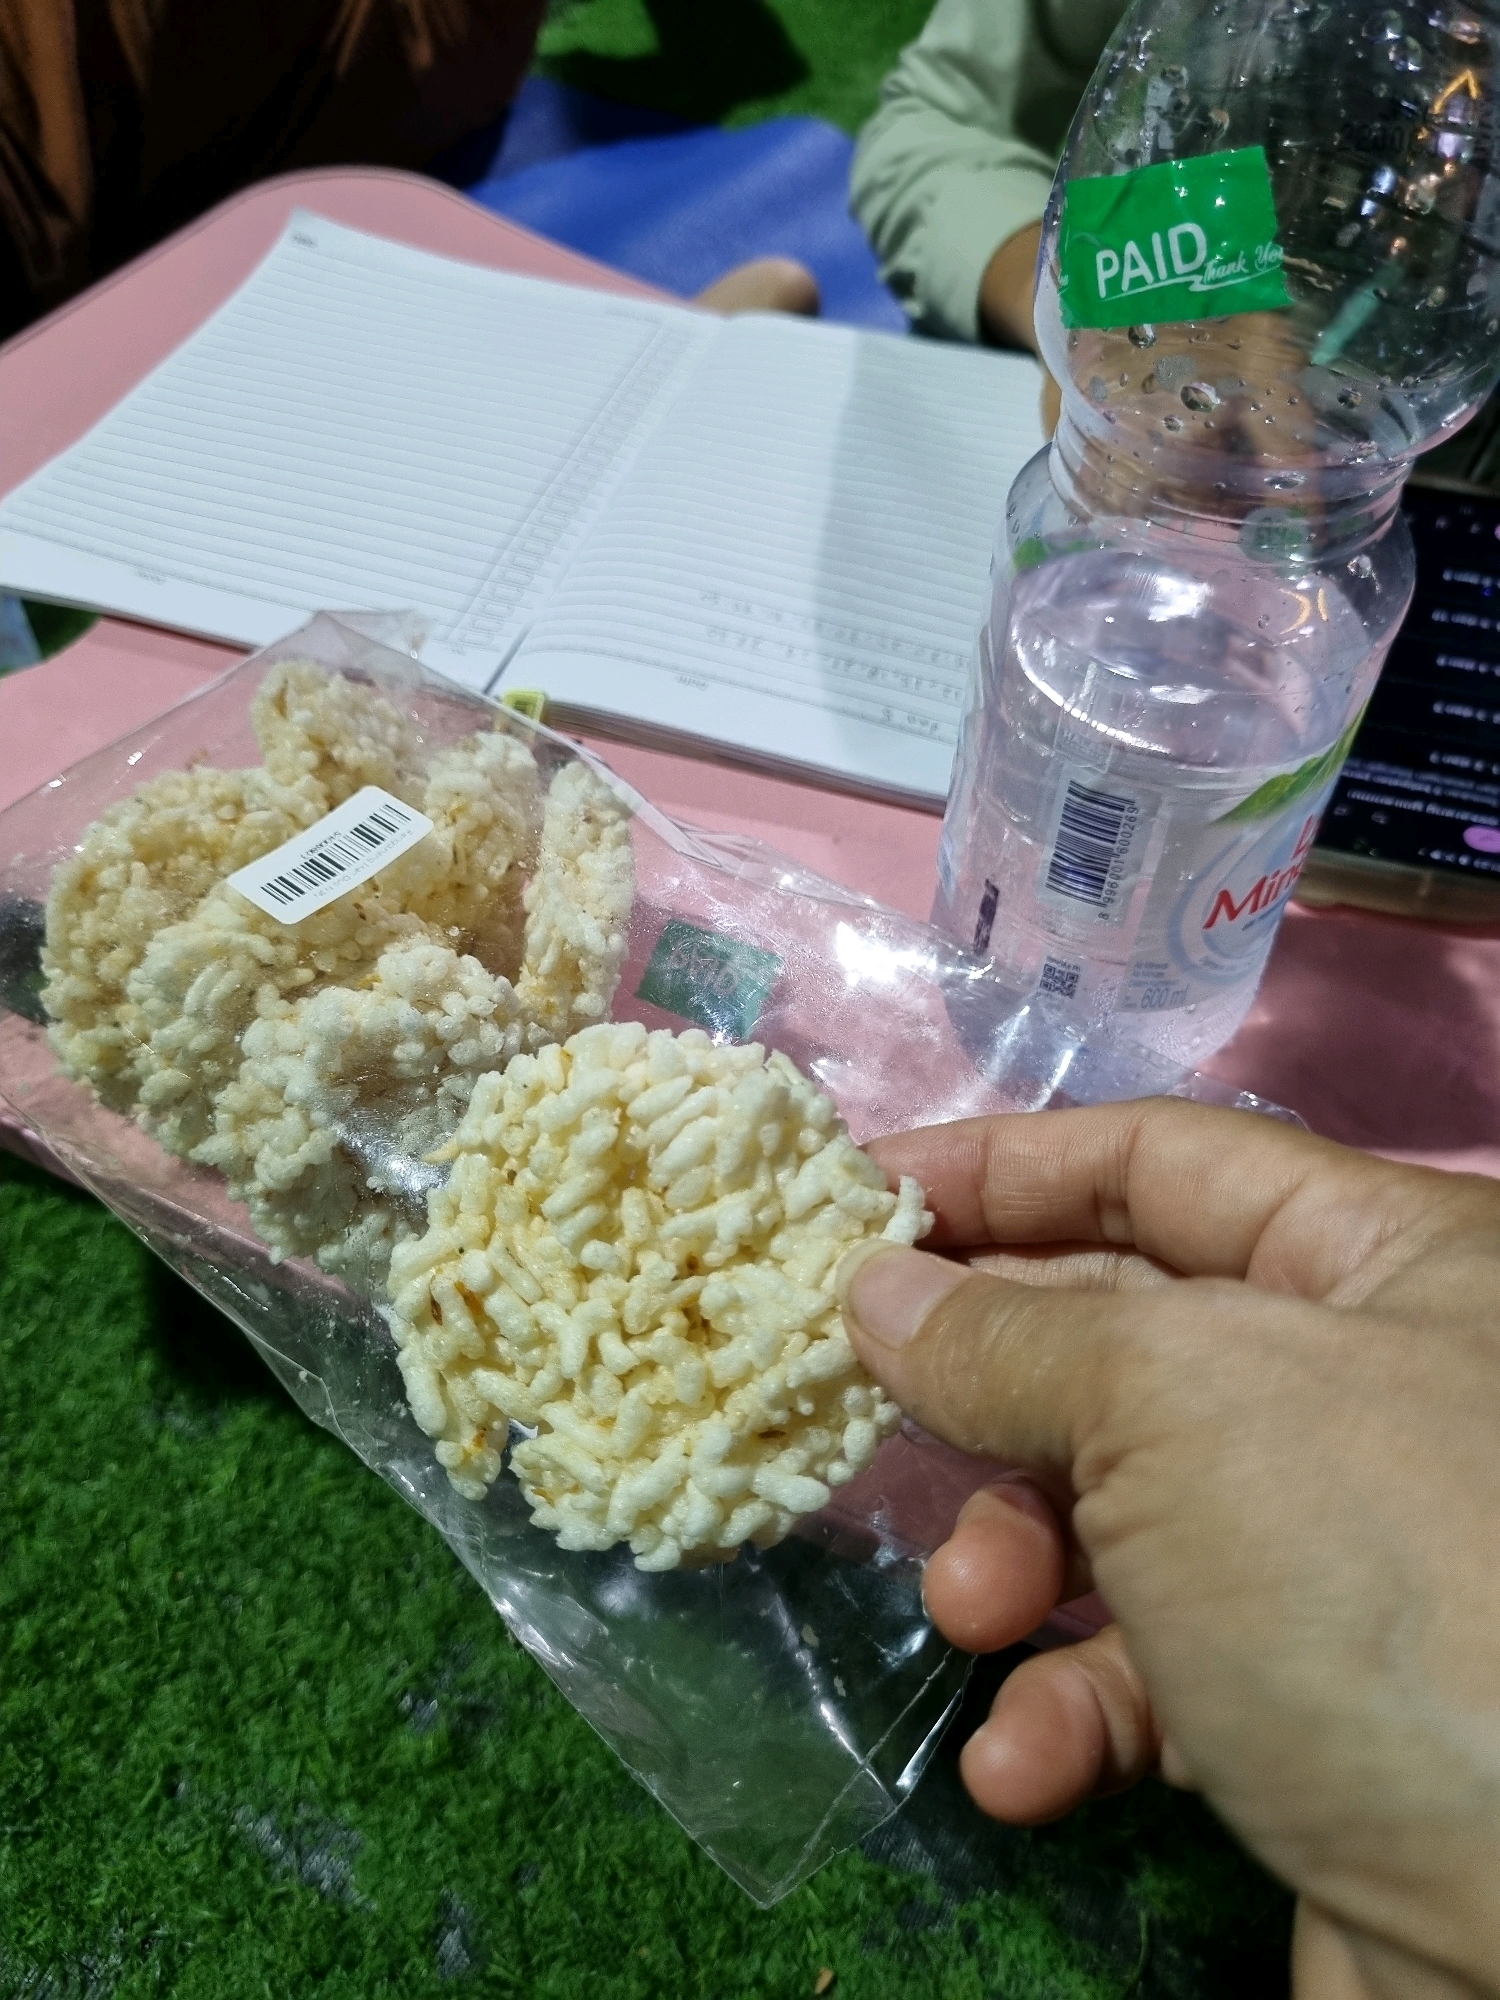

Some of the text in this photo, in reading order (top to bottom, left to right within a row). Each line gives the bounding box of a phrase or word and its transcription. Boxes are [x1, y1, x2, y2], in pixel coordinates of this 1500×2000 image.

[1096, 222, 1207, 298] PAID
[1203, 250, 1250, 285] Thank
[1097, 806, 1139, 921] 8 996001 600269
[1140, 987, 1171, 1009] 600
